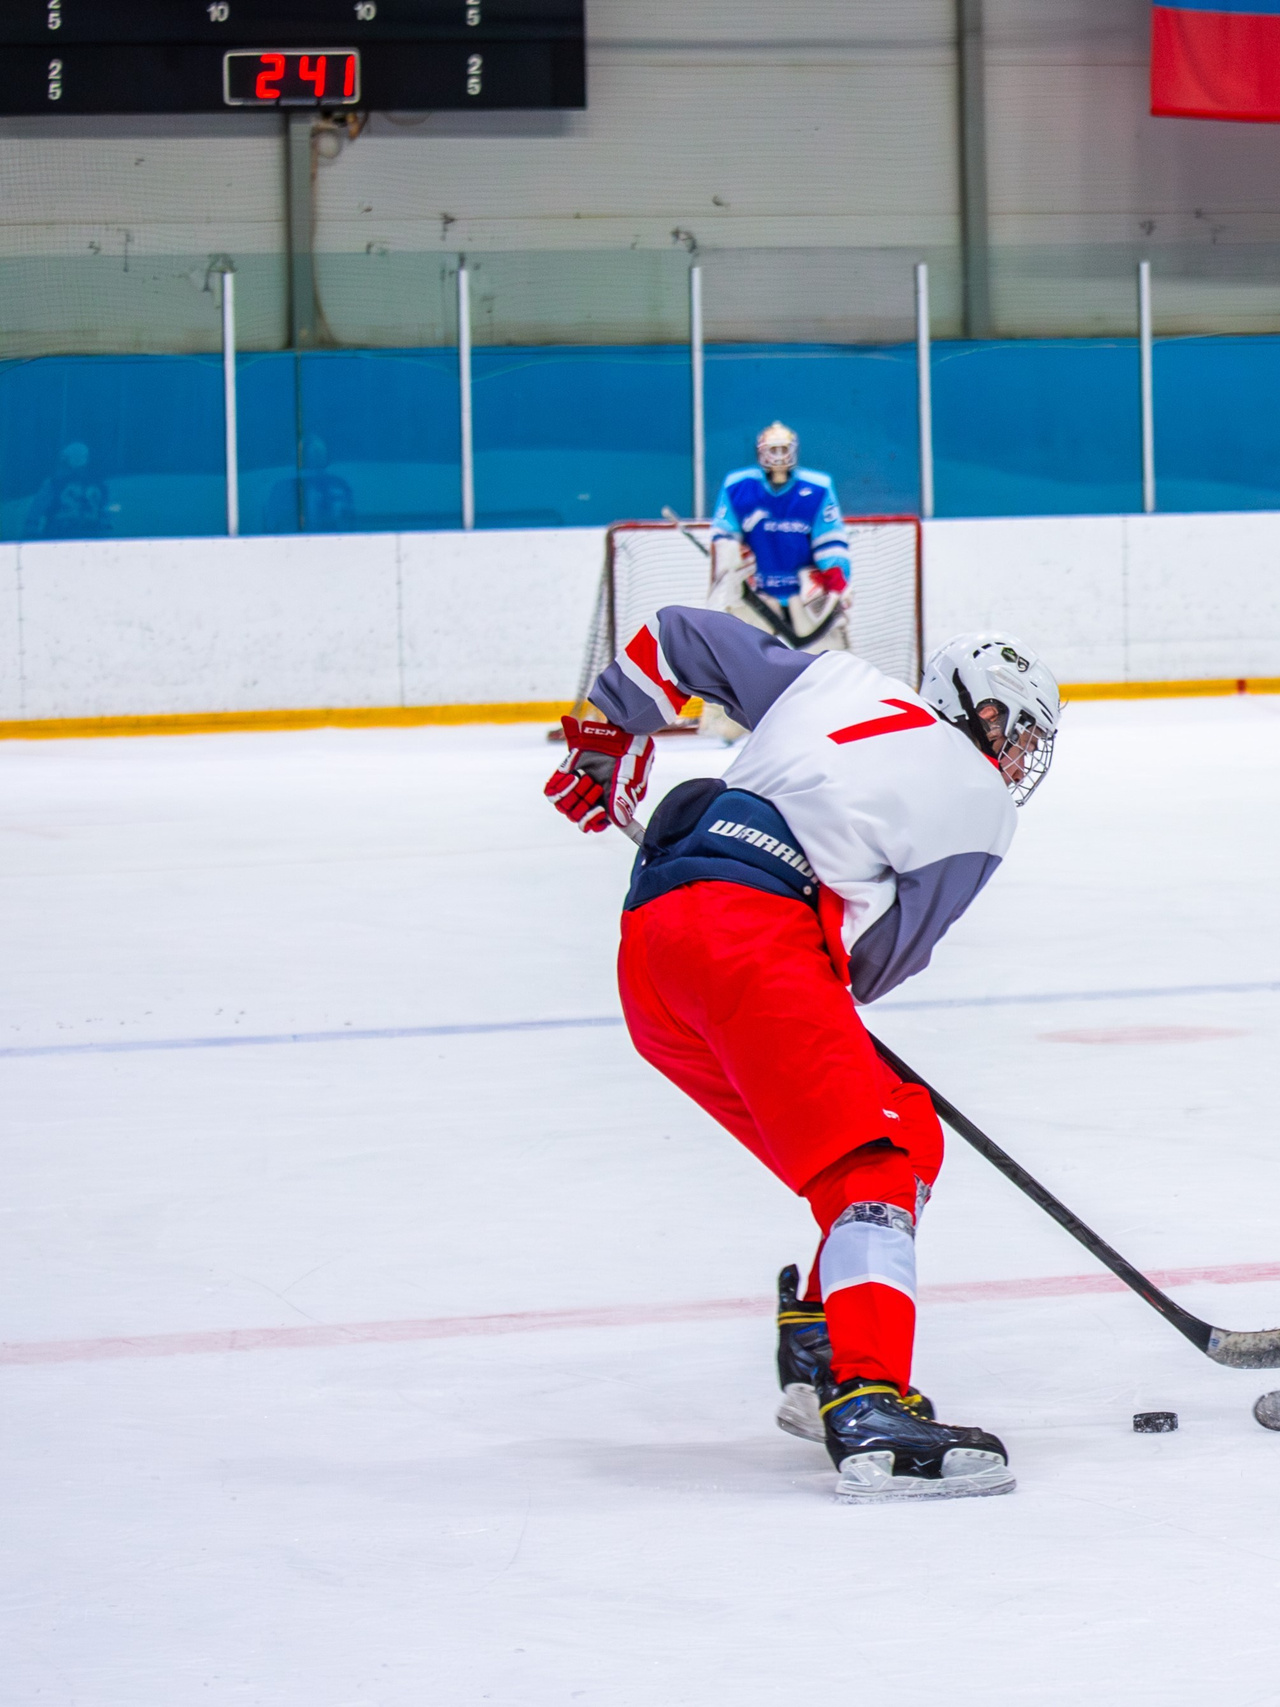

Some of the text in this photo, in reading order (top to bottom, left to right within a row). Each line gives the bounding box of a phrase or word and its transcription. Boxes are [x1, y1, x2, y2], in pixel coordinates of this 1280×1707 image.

[207, 1, 230, 22] 10
[354, 0, 377, 21] 10
[255, 53, 356, 99] 241
[583, 726, 617, 737] CCM
[707, 819, 820, 888] WARRIO
